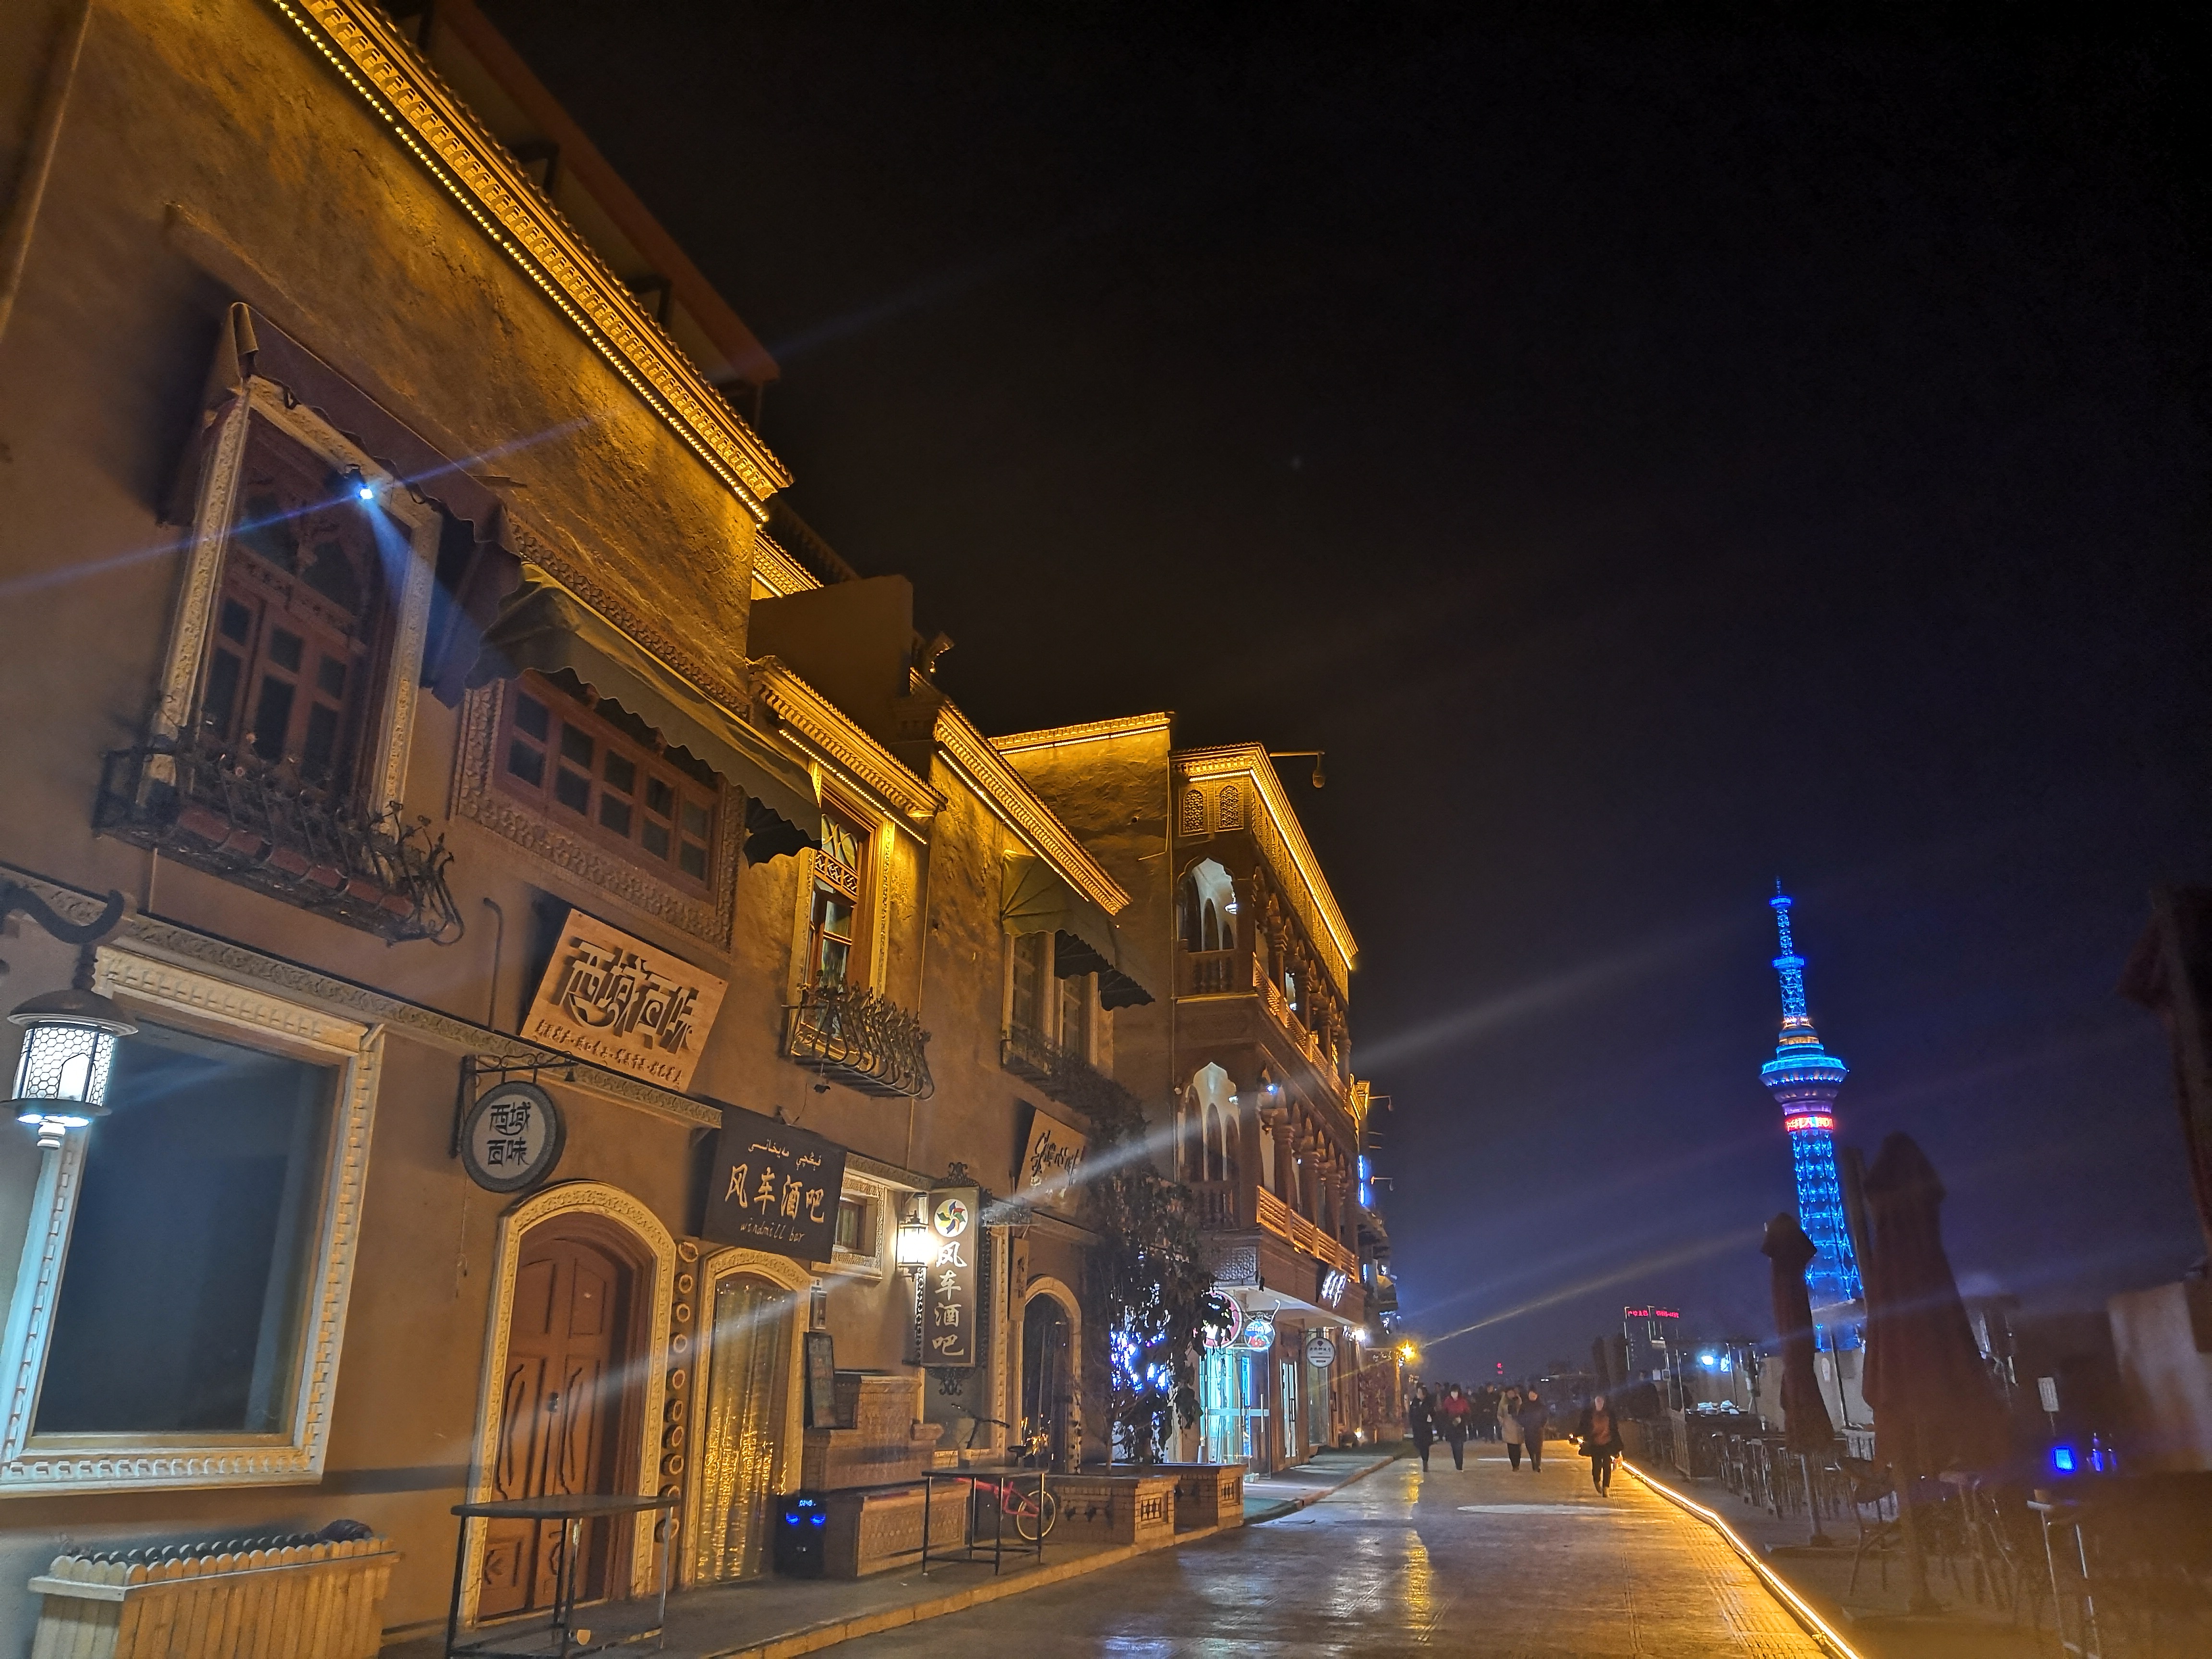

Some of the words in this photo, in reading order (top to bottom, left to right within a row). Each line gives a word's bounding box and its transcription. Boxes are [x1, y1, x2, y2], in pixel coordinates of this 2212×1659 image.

[490, 1101, 530, 1135] 西域
[487, 1137, 529, 1166] 百味
[724, 1163, 825, 1224] 风车酒吧
[740, 1217, 786, 1240] windmill
[789, 1225, 805, 1242] bar
[932, 1241, 966, 1356] 风车酒吧
